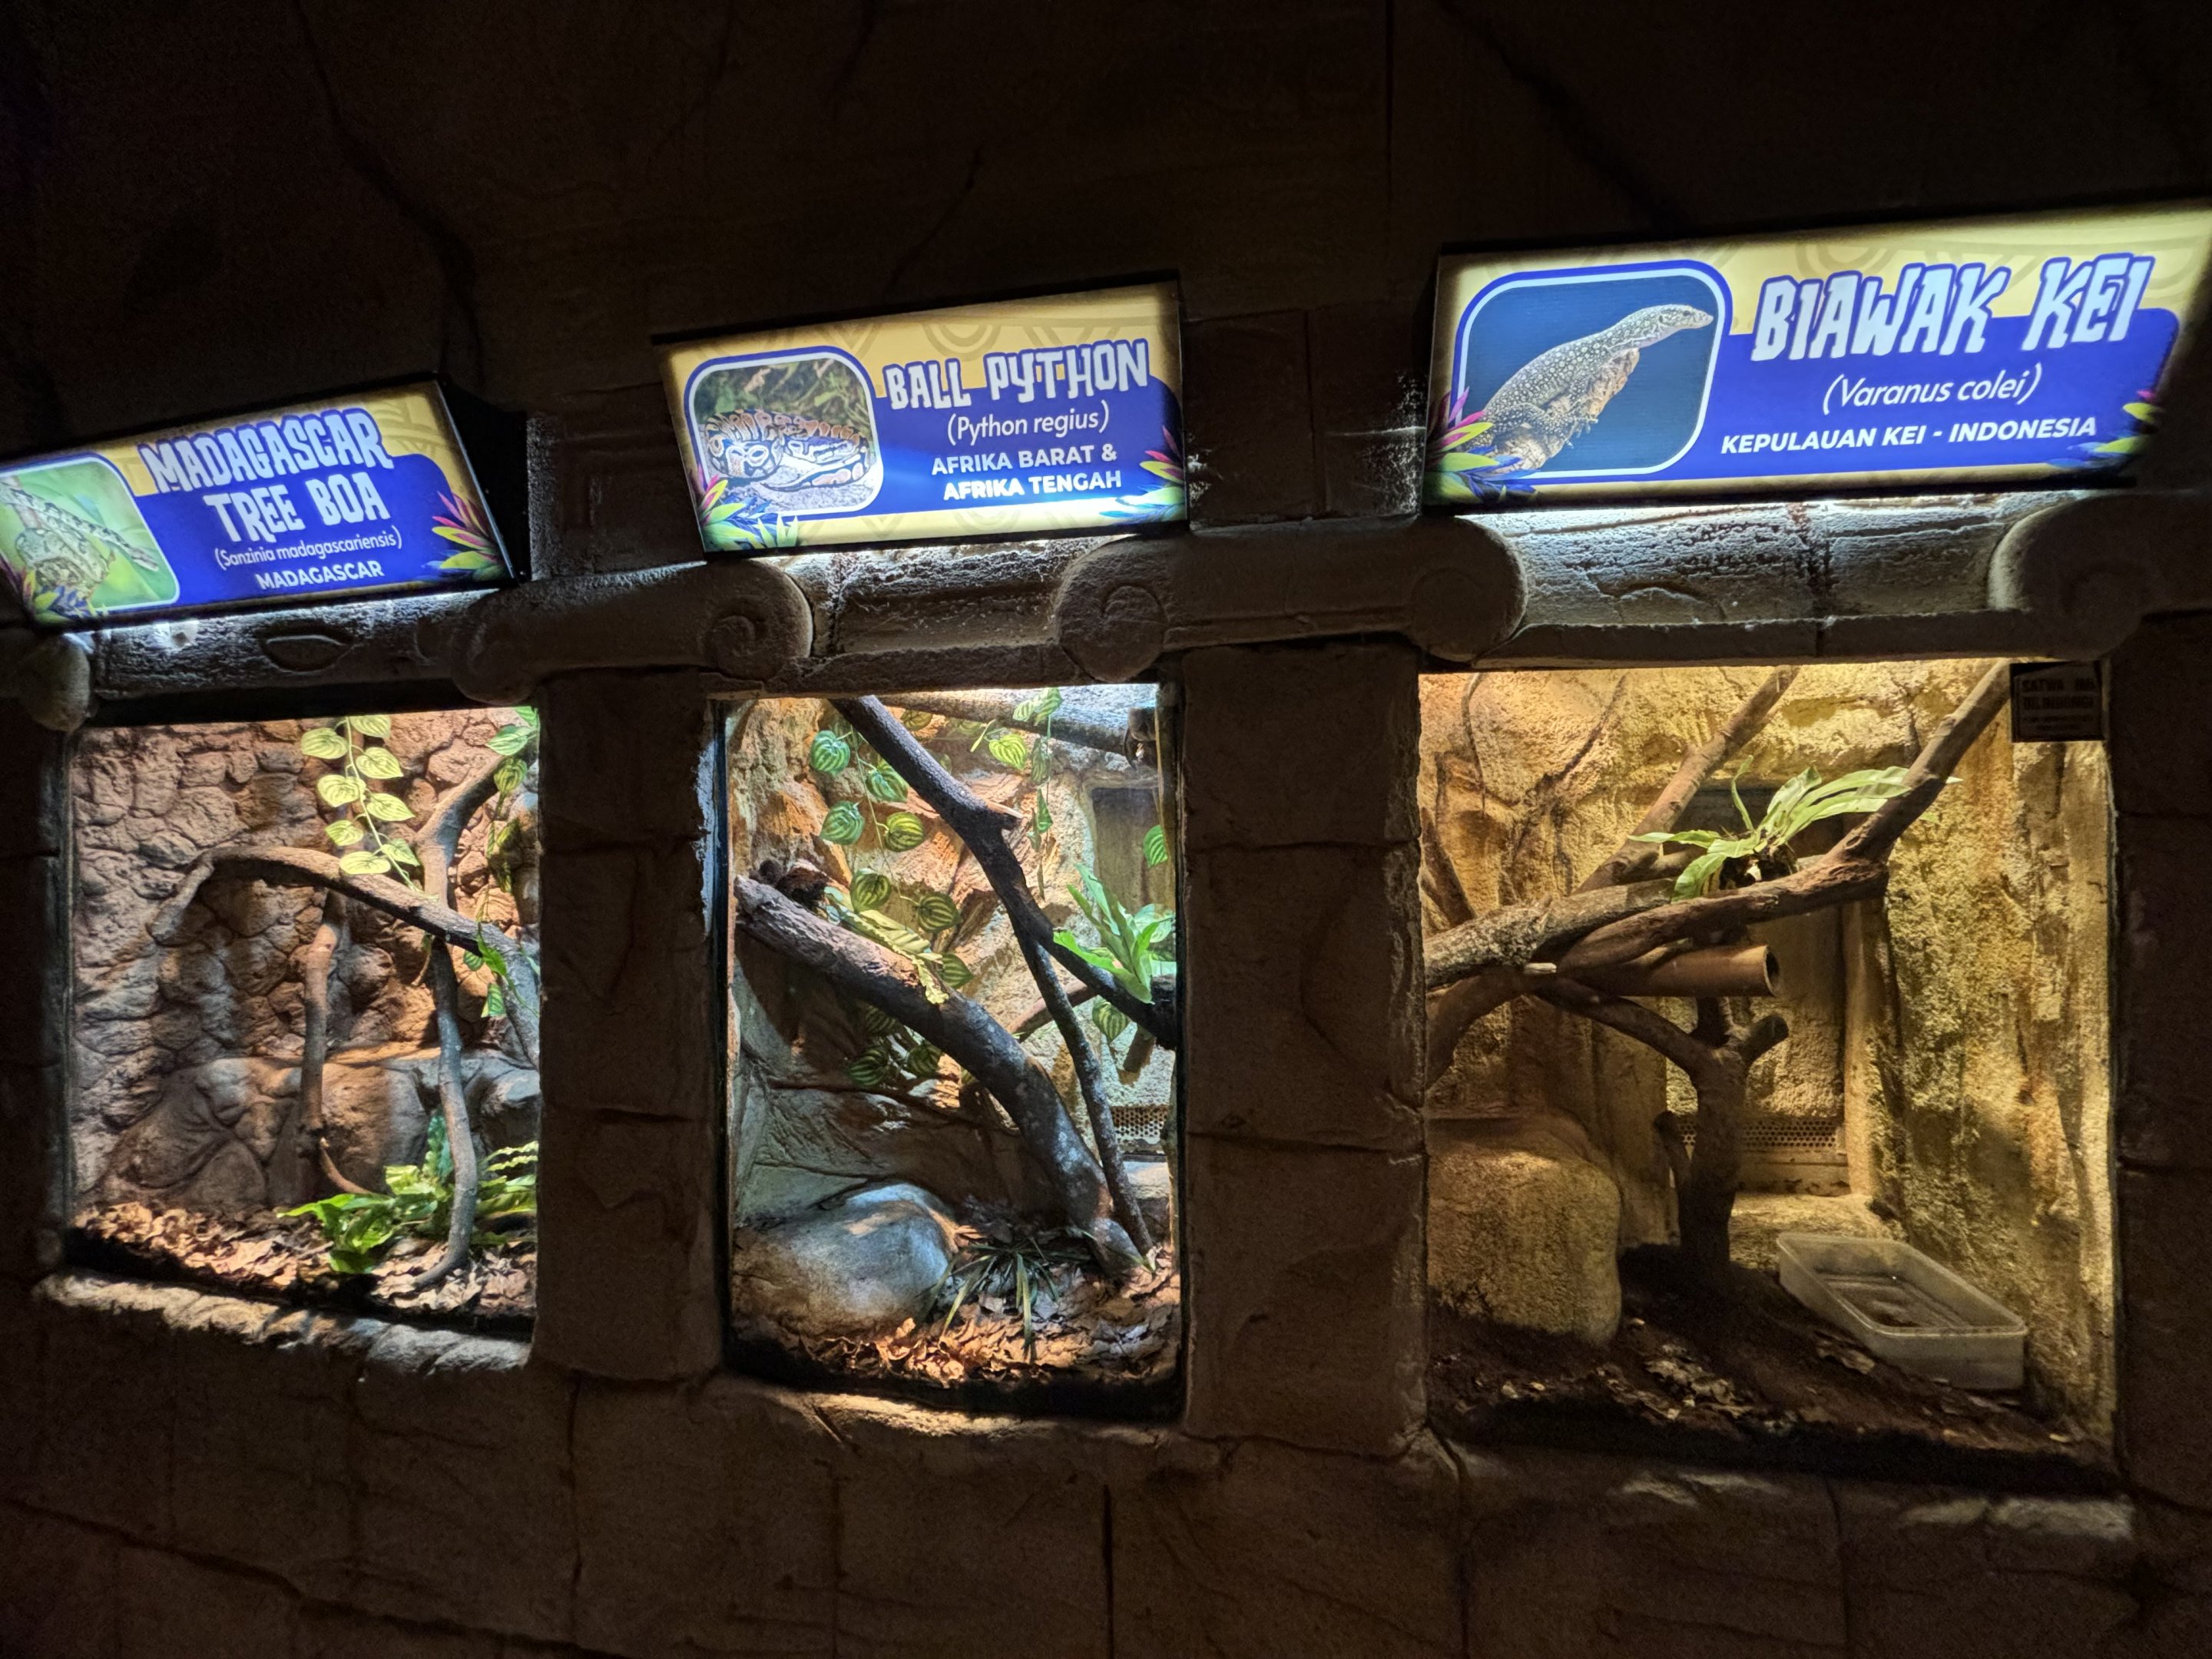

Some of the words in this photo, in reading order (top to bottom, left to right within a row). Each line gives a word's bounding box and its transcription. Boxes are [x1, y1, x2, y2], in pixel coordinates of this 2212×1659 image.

[1750, 262, 2012, 362] BIAWAK
[2021, 253, 2156, 351] KEI
[883, 358, 972, 409] BALL
[985, 339, 1148, 403] PYTHON
[1823, 374, 1952, 415] (Varanus
[1957, 363, 2042, 405] colei)
[947, 413, 1028, 446] (Python
[1034, 399, 1110, 438] regius)
[1721, 427, 1878, 454] KEPULAUAN
[1882, 426, 1926, 445] KEI
[1949, 418, 2098, 442] INDONESIA
[138, 408, 394, 495] MADAGASCAR
[932, 452, 1013, 475] AFRIKA
[1018, 445, 1094, 469] BARAT
[1101, 444, 1117, 461] &
[203, 484, 305, 545] TREE
[305, 472, 391, 528] BOA
[943, 477, 1025, 500] AFRIKA
[1028, 471, 1121, 494] TENGAH
[214, 545, 276, 571] (Sanzinia
[276, 525, 402, 562] madagascariensis)
[255, 561, 385, 591] MADAGASCAR
